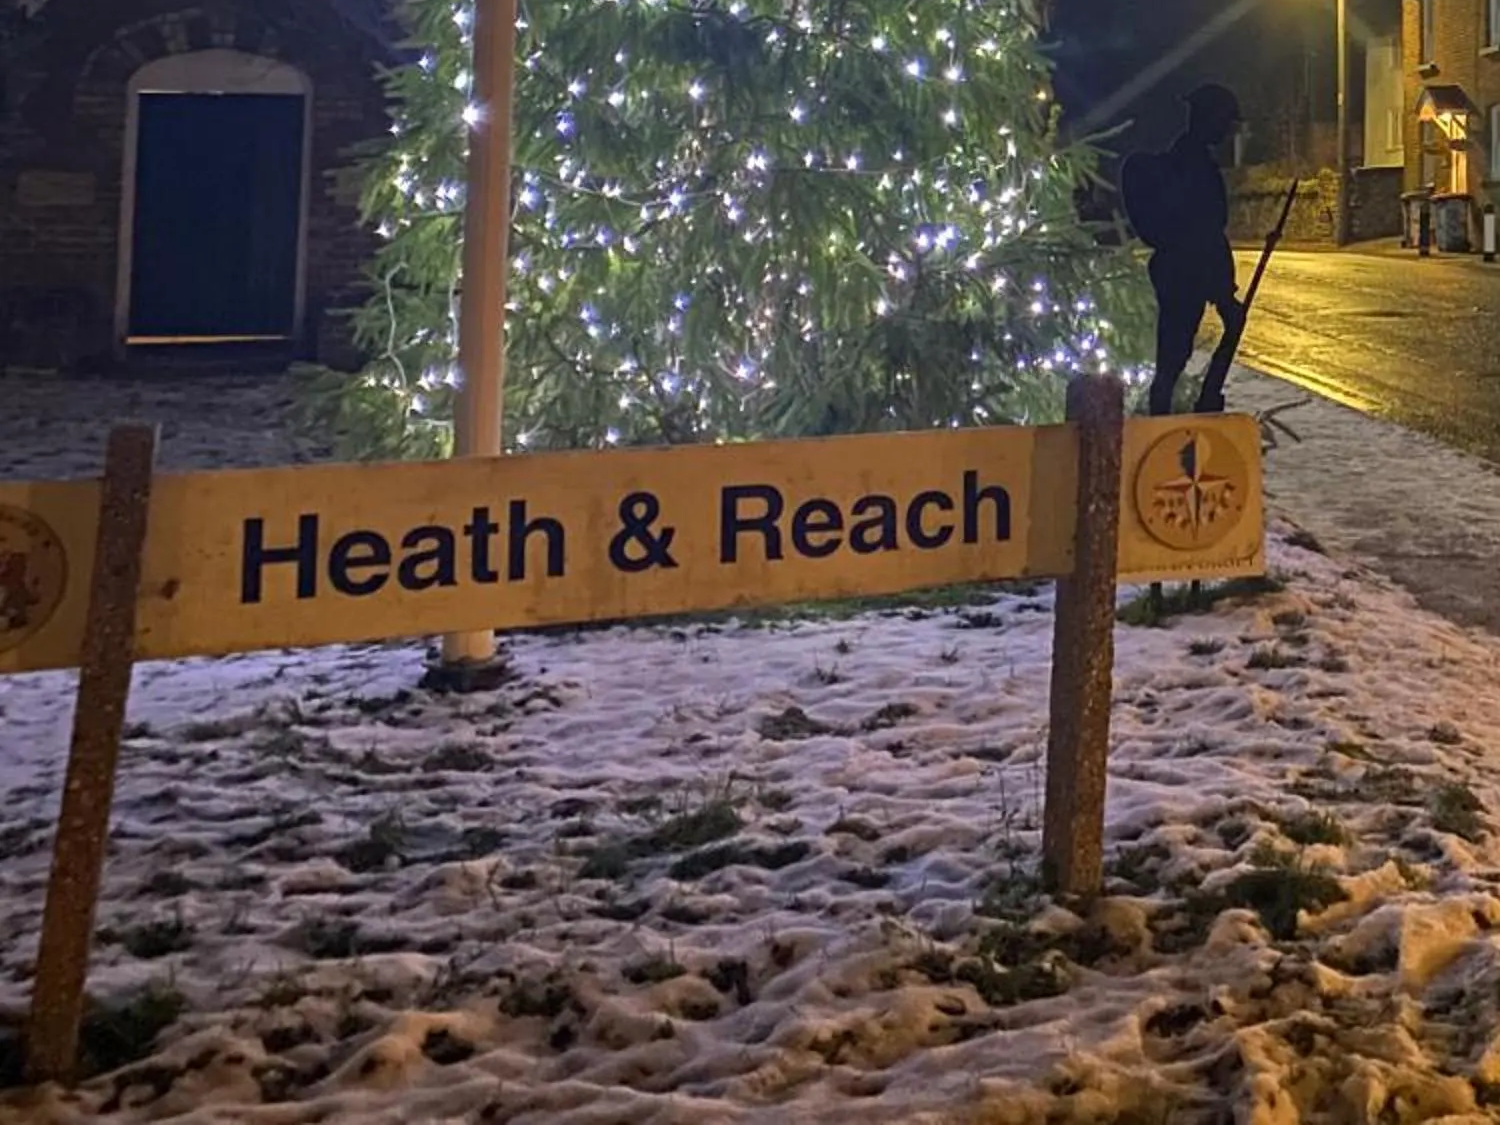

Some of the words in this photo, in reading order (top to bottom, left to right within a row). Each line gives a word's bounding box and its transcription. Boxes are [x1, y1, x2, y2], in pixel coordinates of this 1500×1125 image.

[240, 500, 565, 604] Heath
[608, 491, 679, 573] &
[719, 471, 1011, 564] Reach
